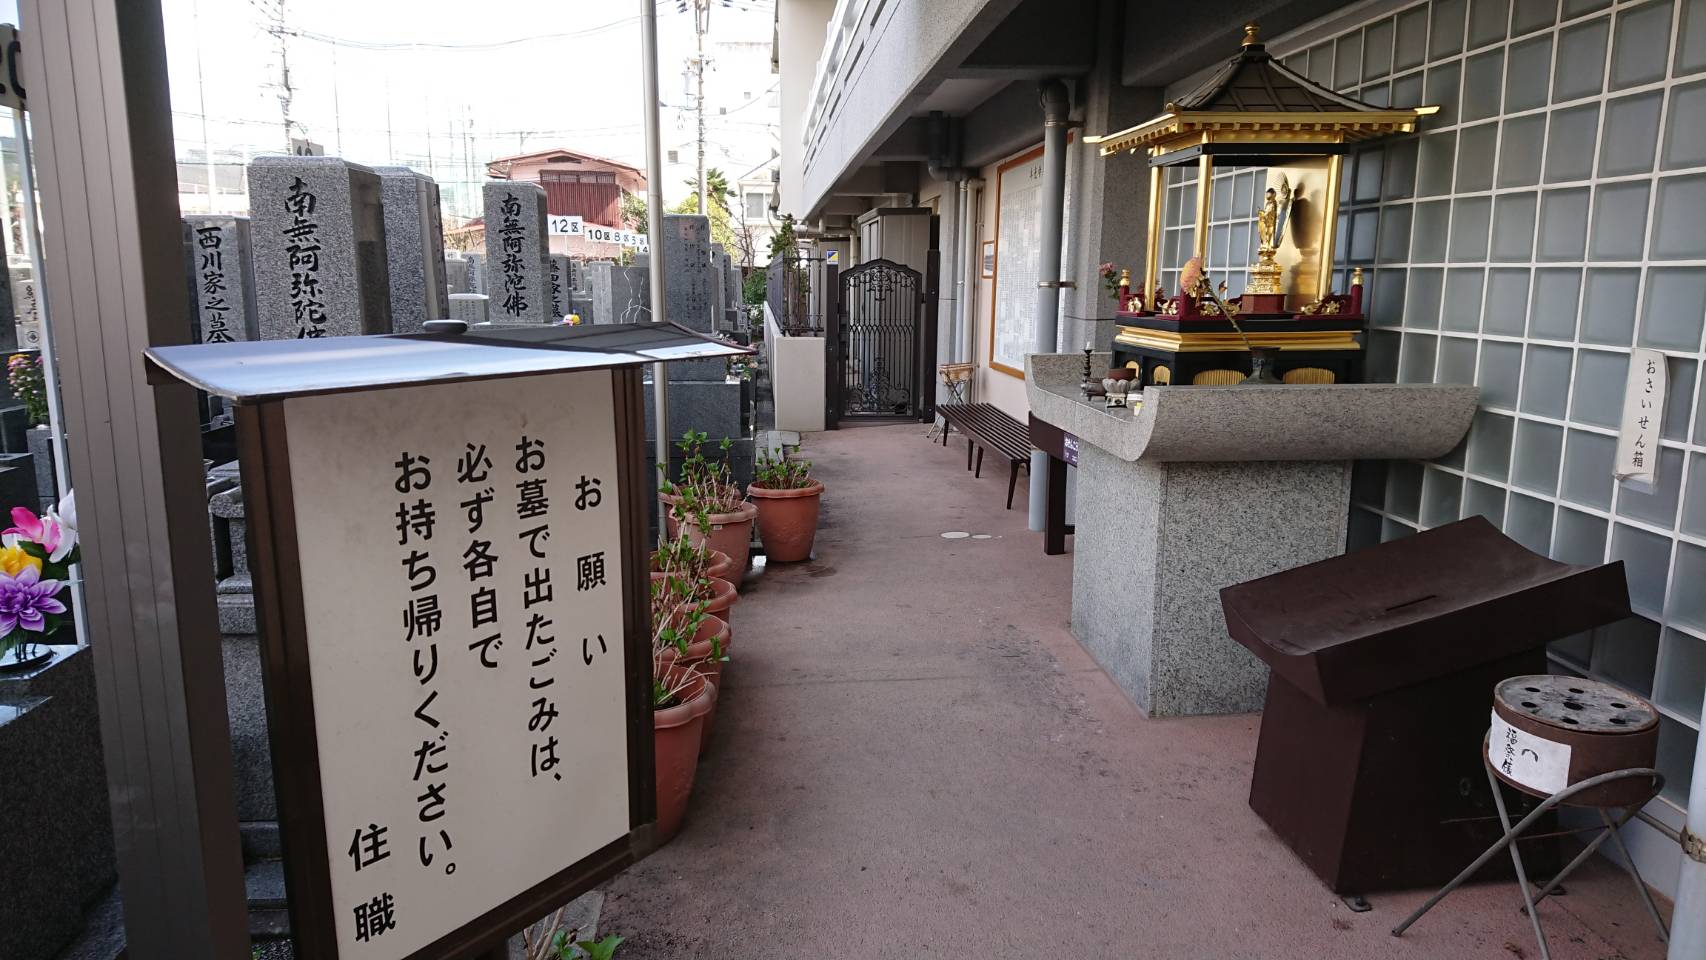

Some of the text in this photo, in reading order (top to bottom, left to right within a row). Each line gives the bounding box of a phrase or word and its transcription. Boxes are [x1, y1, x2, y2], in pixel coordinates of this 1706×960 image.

[196, 226, 235, 344] 西川家之墓
[551, 219, 579, 233] 12区
[588, 229, 611, 241] 10区
[1632, 359, 1656, 468] おさいせん箱
[456, 442, 503, 669] 必ず各自で
[514, 434, 562, 783] お墓で出たごみは、
[574, 475, 608, 666] お願い
[394, 451, 457, 877] お持ち帰りください。
[347, 823, 397, 943] 住職
